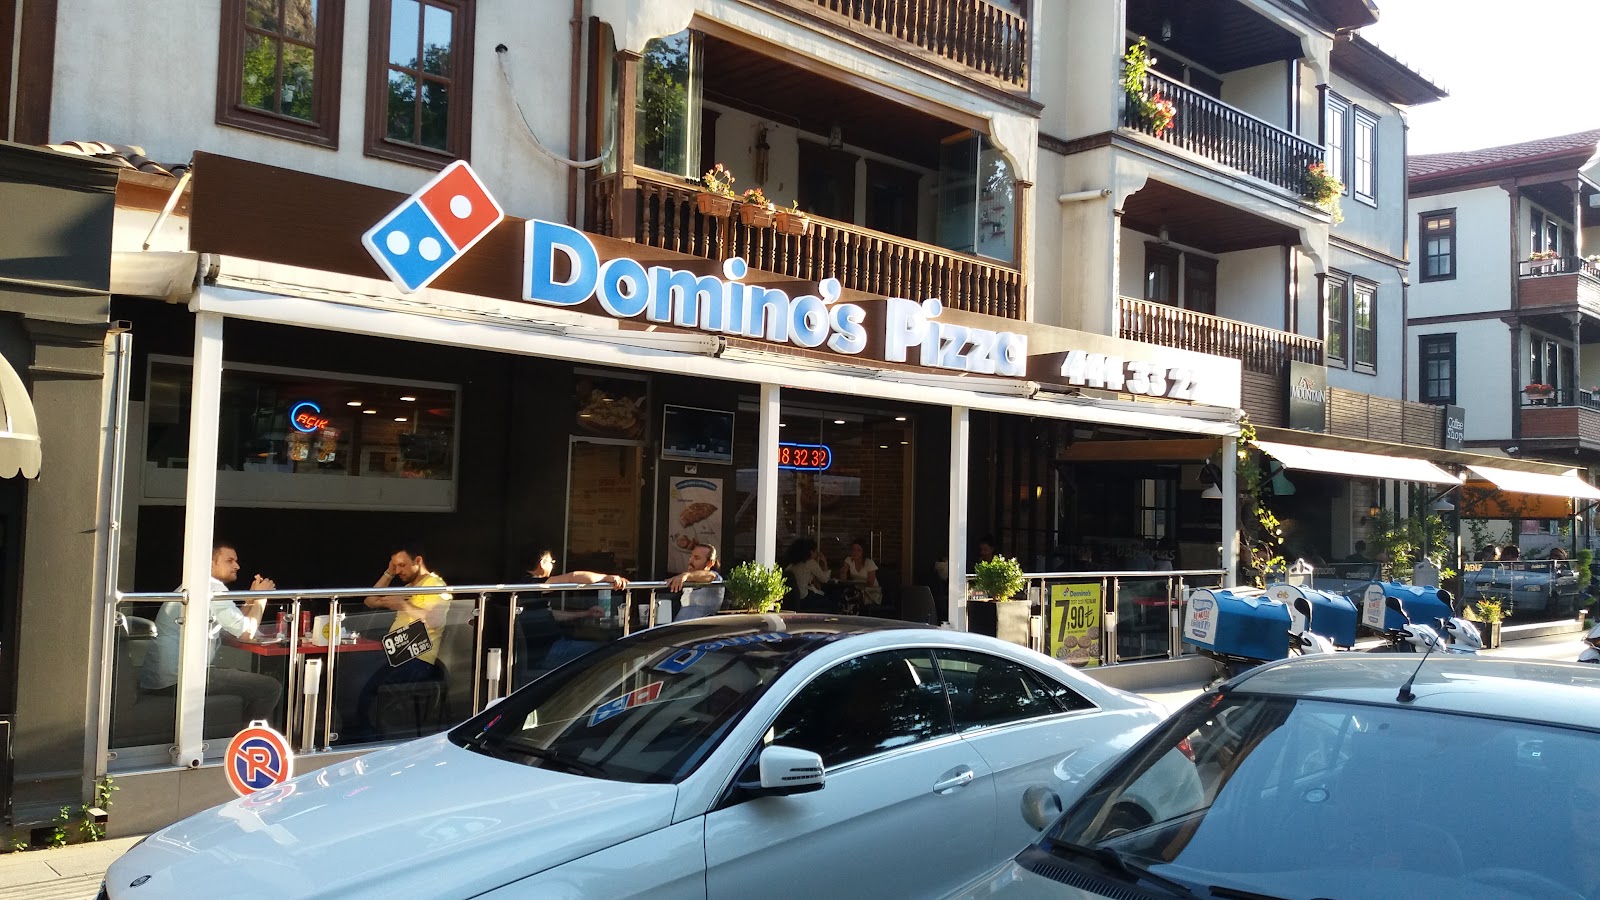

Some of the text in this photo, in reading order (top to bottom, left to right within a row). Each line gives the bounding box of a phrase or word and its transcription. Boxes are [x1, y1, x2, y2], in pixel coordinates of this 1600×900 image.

[523, 218, 1028, 378] Domino's Pizza
[1060, 349, 1124, 391] 444
[1126, 361, 1168, 397] 33
[1290, 384, 1326, 403] MOUNTAIN
[1448, 417, 1463, 430] Coffee
[793, 449, 808, 466] 32
[811, 450, 827, 467] 32
